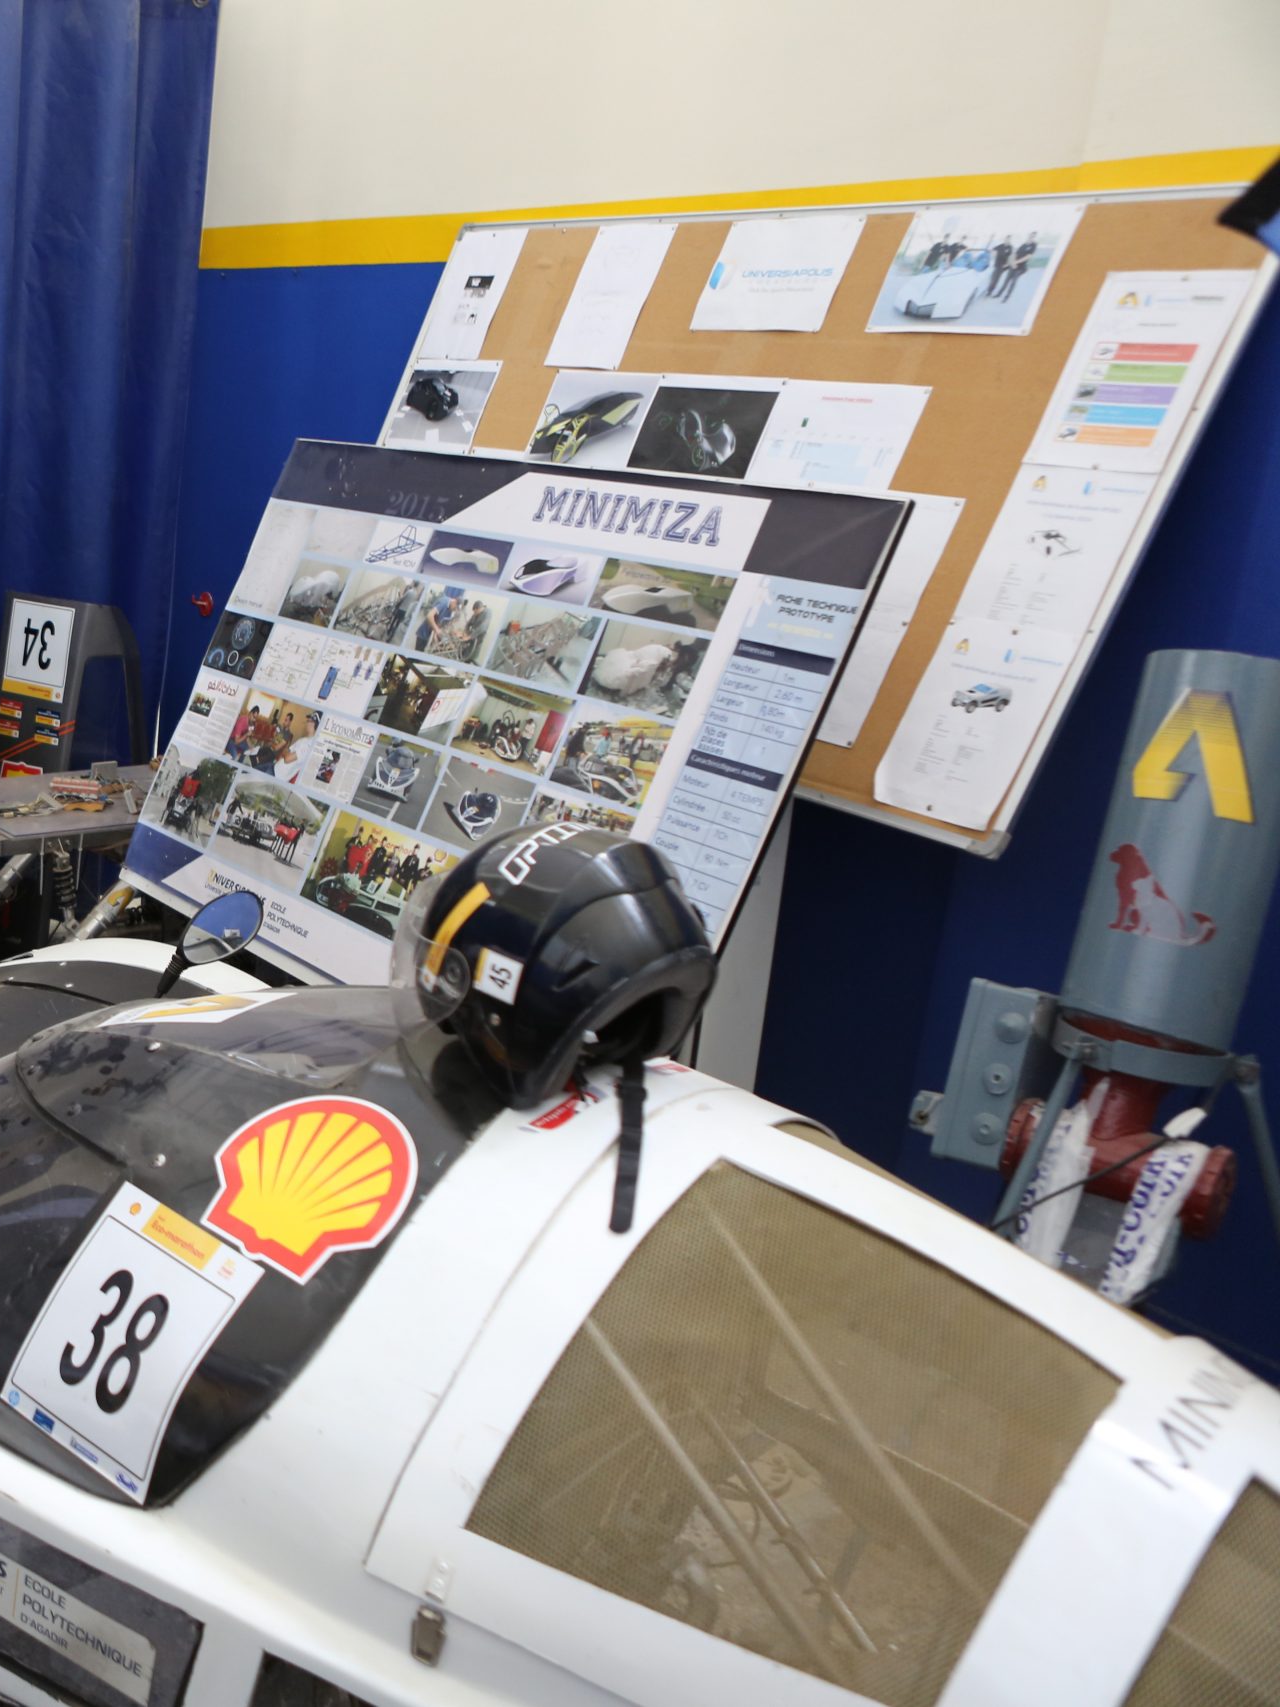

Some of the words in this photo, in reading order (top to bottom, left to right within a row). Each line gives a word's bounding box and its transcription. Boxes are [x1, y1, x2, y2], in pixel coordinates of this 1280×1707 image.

[532, 485, 722, 547] MINIMIZA
[776, 593, 804, 606] FICHE
[807, 599, 858, 615] TECHNIQUE
[778, 607, 835, 623] PROTOTYPE
[22, 618, 55, 670] 34
[267, 911, 309, 938] POLYTECHNIQUE
[271, 901, 287, 914] ECOLE
[488, 962, 513, 990] 45
[59, 1269, 169, 1414] 38
[24, 1574, 67, 1609] ECOLE
[20, 1612, 68, 1650] D'AGADIR
[23, 1594, 142, 1678] POLYTECHNIQUE
